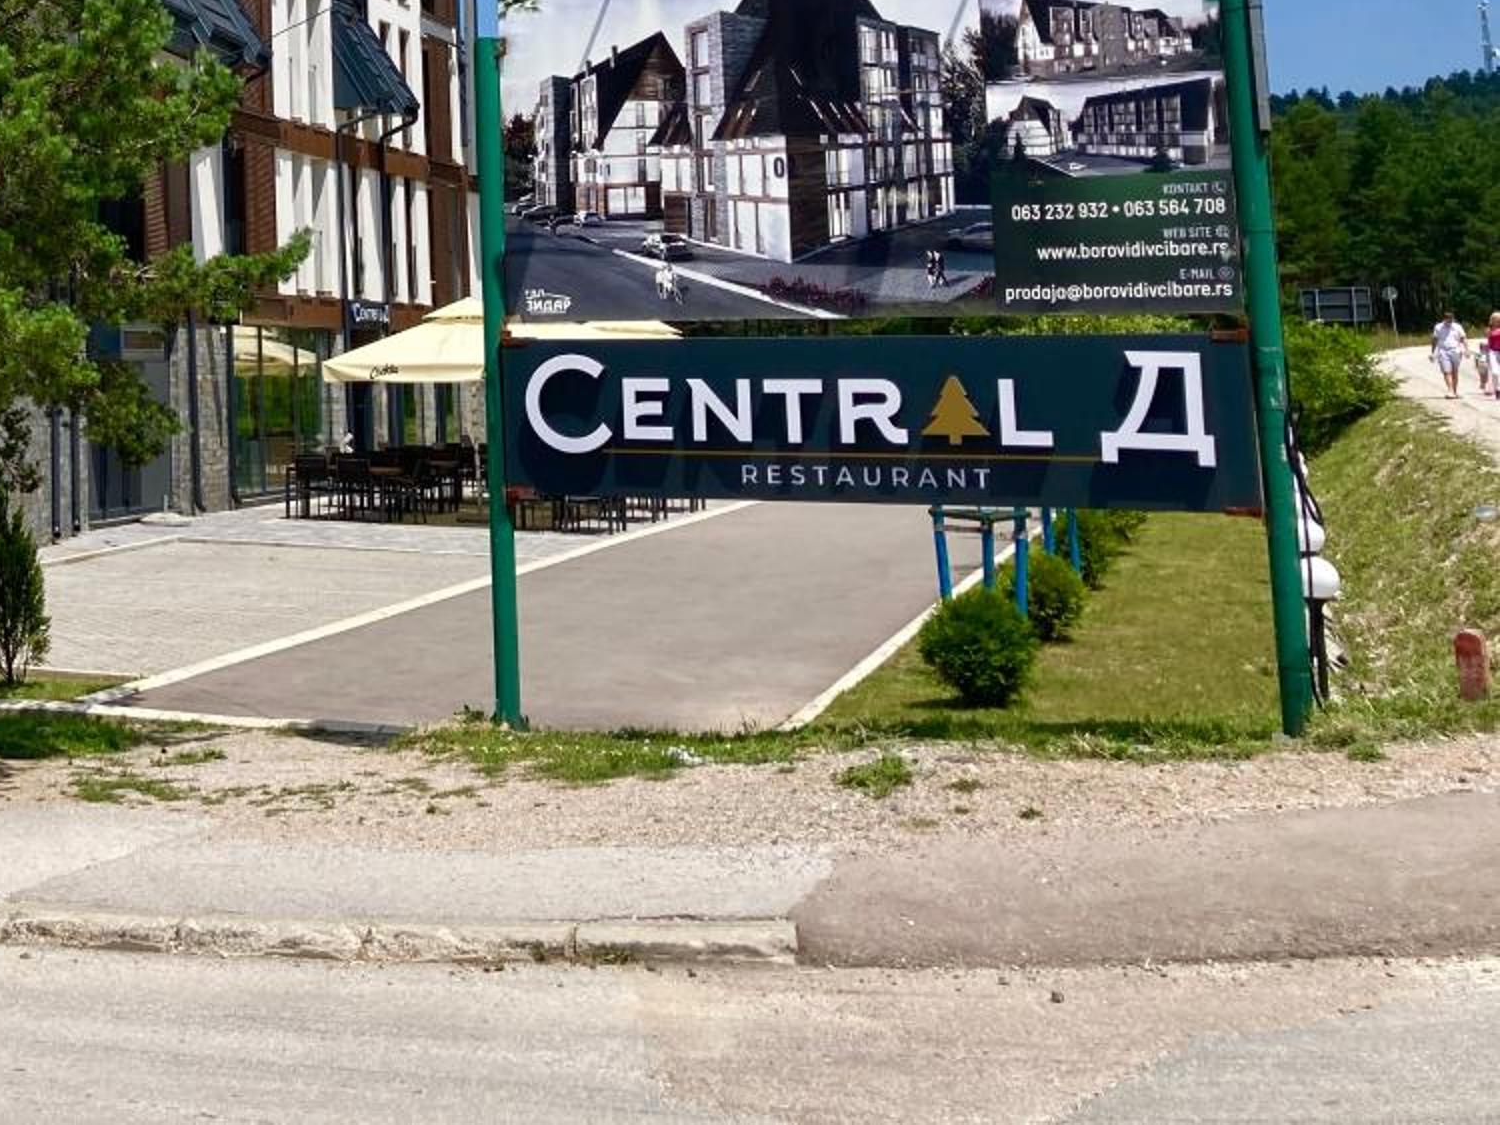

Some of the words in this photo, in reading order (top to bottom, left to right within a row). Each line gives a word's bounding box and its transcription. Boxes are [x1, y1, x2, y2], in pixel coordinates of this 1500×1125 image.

[1163, 182, 1208, 195] KONTAKT
[1011, 204, 1041, 221] 063
[1045, 203, 1074, 220] 232
[1079, 201, 1109, 218] 932
[1124, 200, 1155, 217] 063
[1159, 198, 1189, 216] 564
[1194, 197, 1226, 215] 708
[1163, 227, 1187, 239] WEB
[1188, 226, 1212, 238] SITE
[1179, 268, 1215, 280] E-MAIL
[1005, 281, 1233, 304] prodaja@borovidivcibare.rs
[740, 463, 992, 489] RESTAURANT
